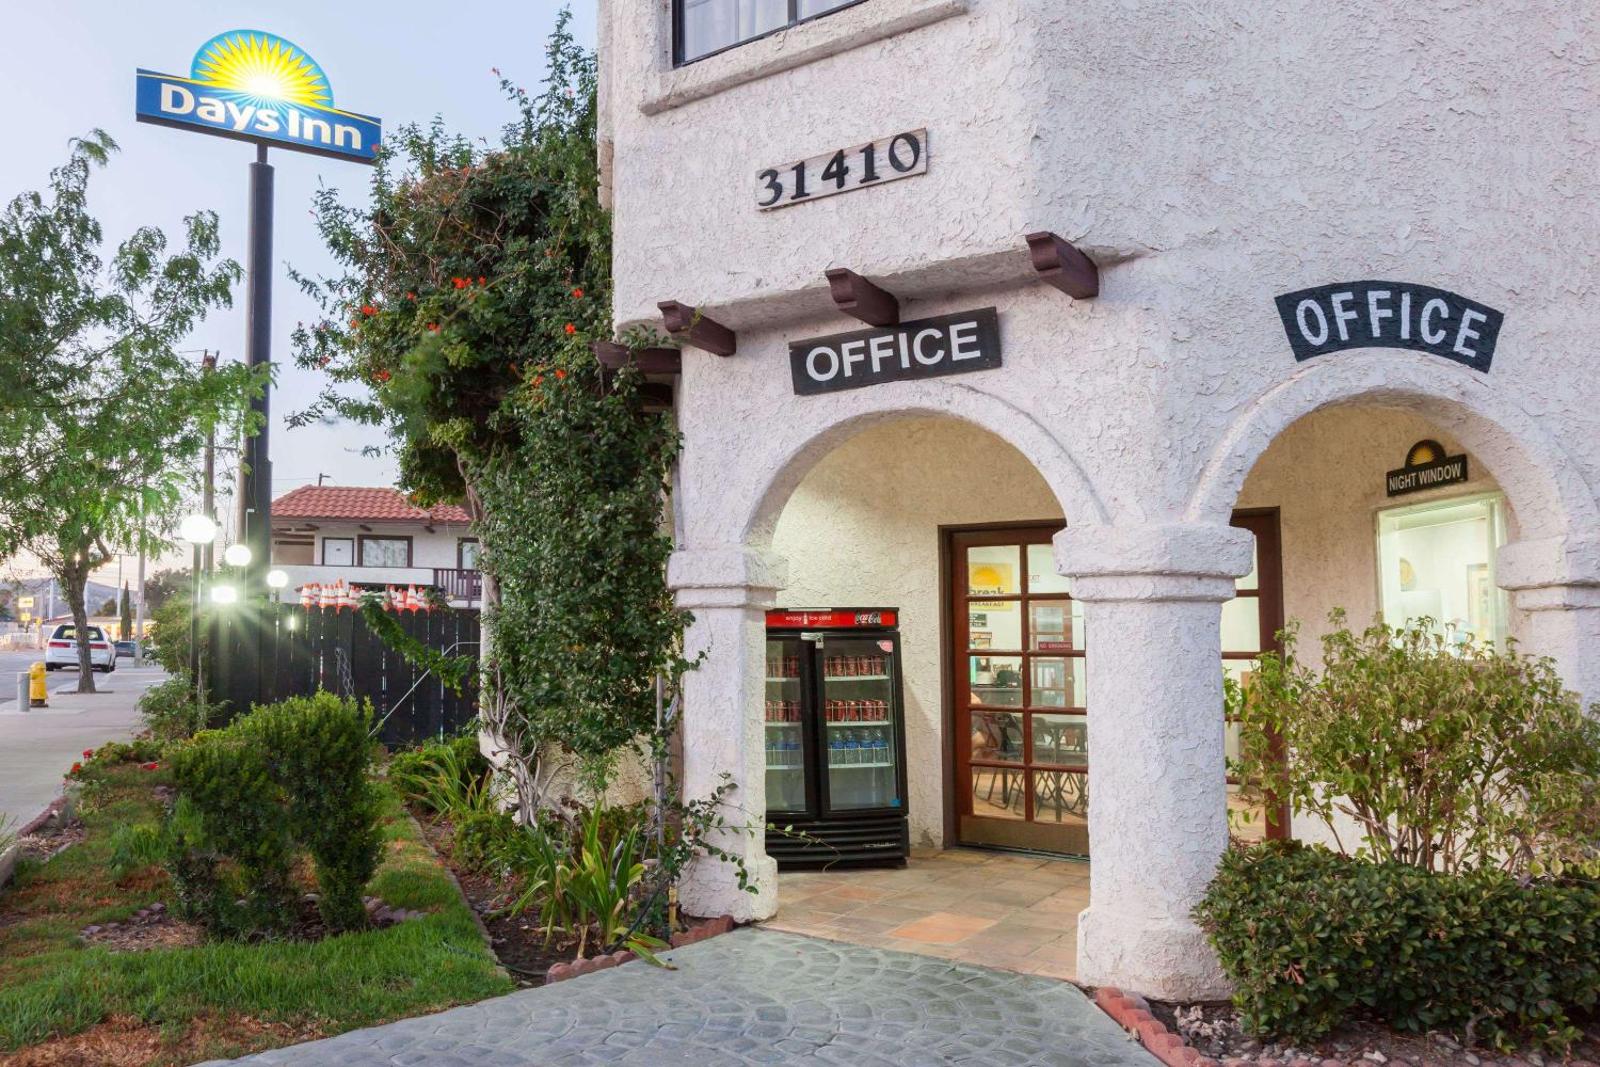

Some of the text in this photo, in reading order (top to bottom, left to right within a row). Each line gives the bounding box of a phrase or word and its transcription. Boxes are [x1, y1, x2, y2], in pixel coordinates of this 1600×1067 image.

[160, 82, 362, 150] Days Inn
[758, 132, 921, 207] 31410
[805, 321, 982, 382] OFFICE
[1296, 290, 1487, 358] OFFICE
[1389, 462, 1462, 492] NIGHT WINDOW
